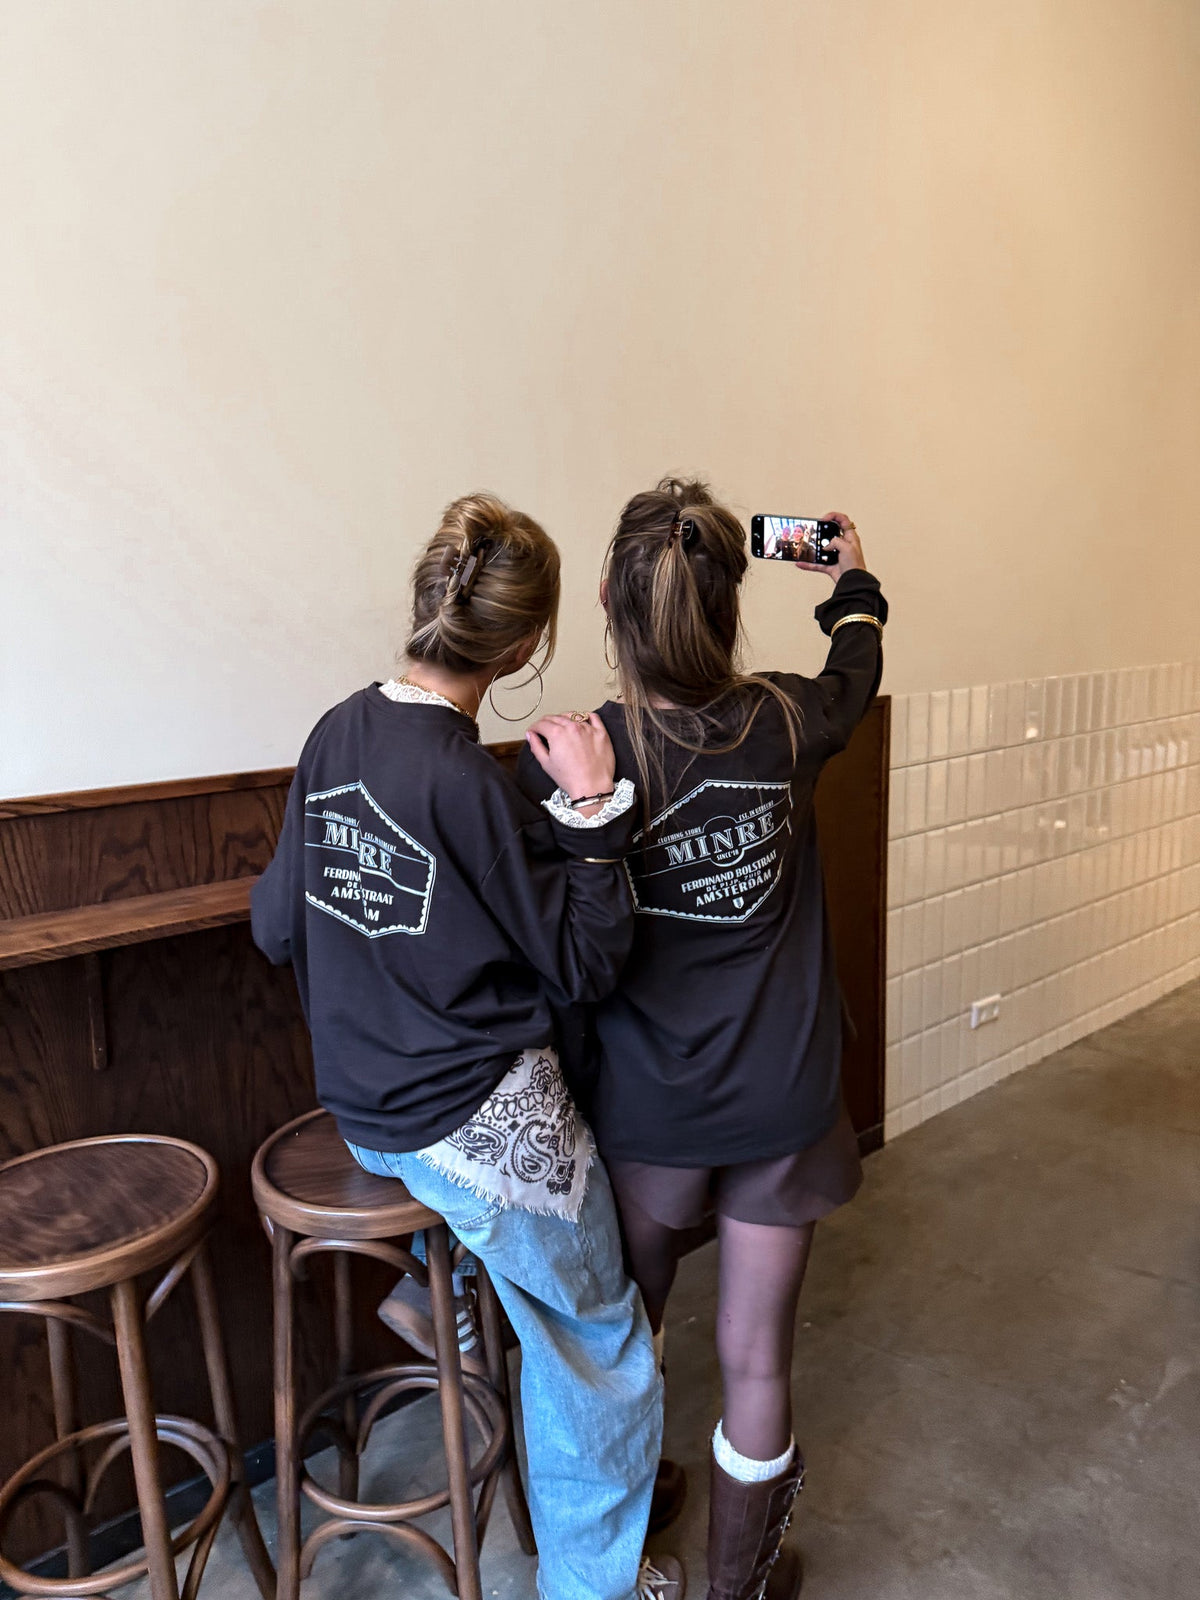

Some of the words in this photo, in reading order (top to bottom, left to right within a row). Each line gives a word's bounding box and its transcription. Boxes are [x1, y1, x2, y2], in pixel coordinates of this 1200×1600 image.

[657, 831, 684, 844] CLOTHING
[664, 811, 775, 867] MINRE
[681, 870, 735, 894] FERDINAND
[735, 848, 777, 878] BOLSTRAAT
[696, 868, 772, 907] AMSTERDAM
[706, 884, 717, 893] DE
